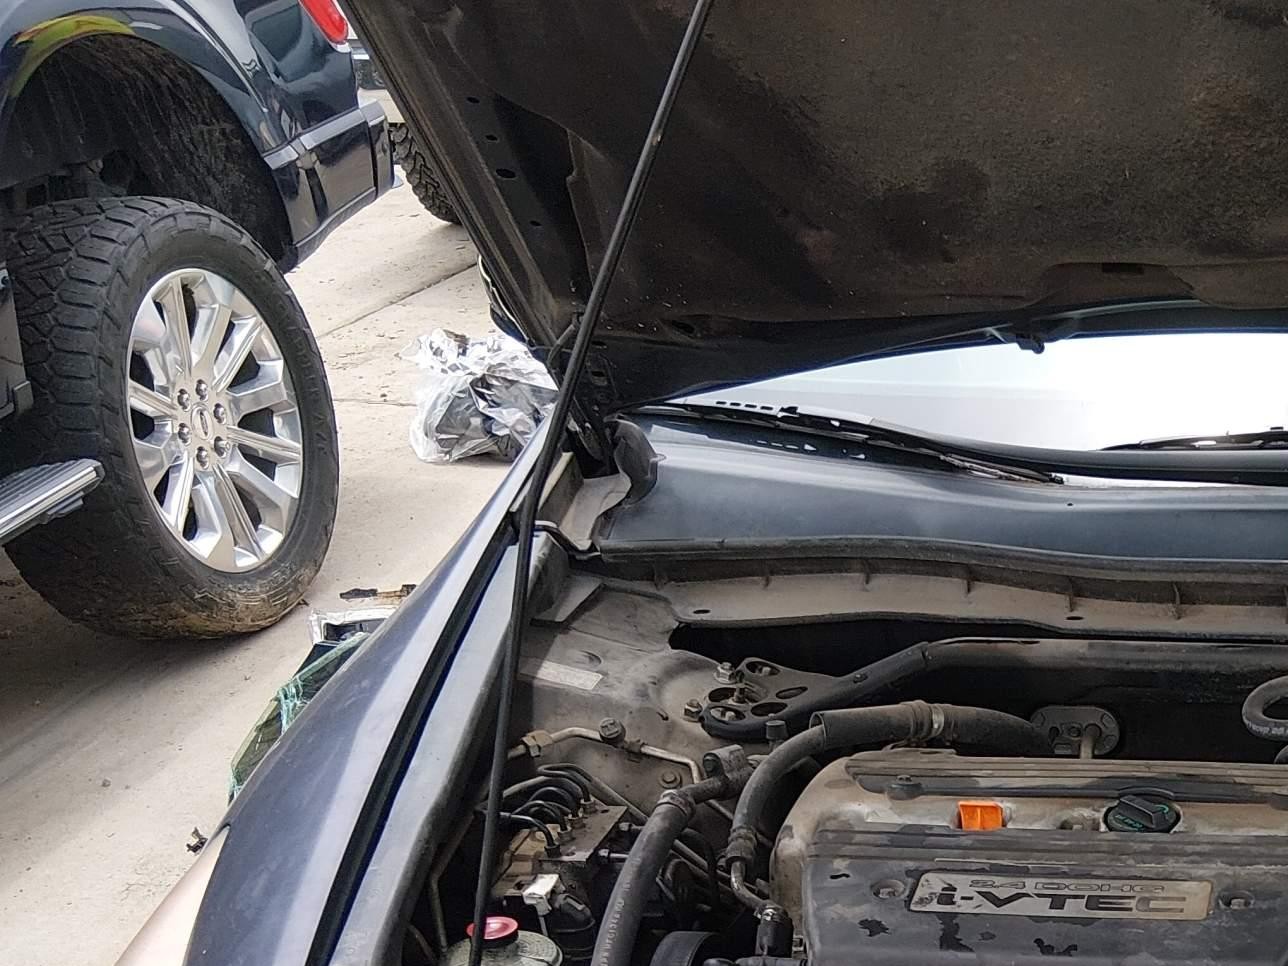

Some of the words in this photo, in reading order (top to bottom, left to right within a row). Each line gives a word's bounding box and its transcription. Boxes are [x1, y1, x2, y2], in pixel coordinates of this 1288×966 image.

[968, 879, 1026, 891] 2.4
[1034, 881, 1165, 894] DOHC
[936, 884, 1187, 914] i-VTEC
